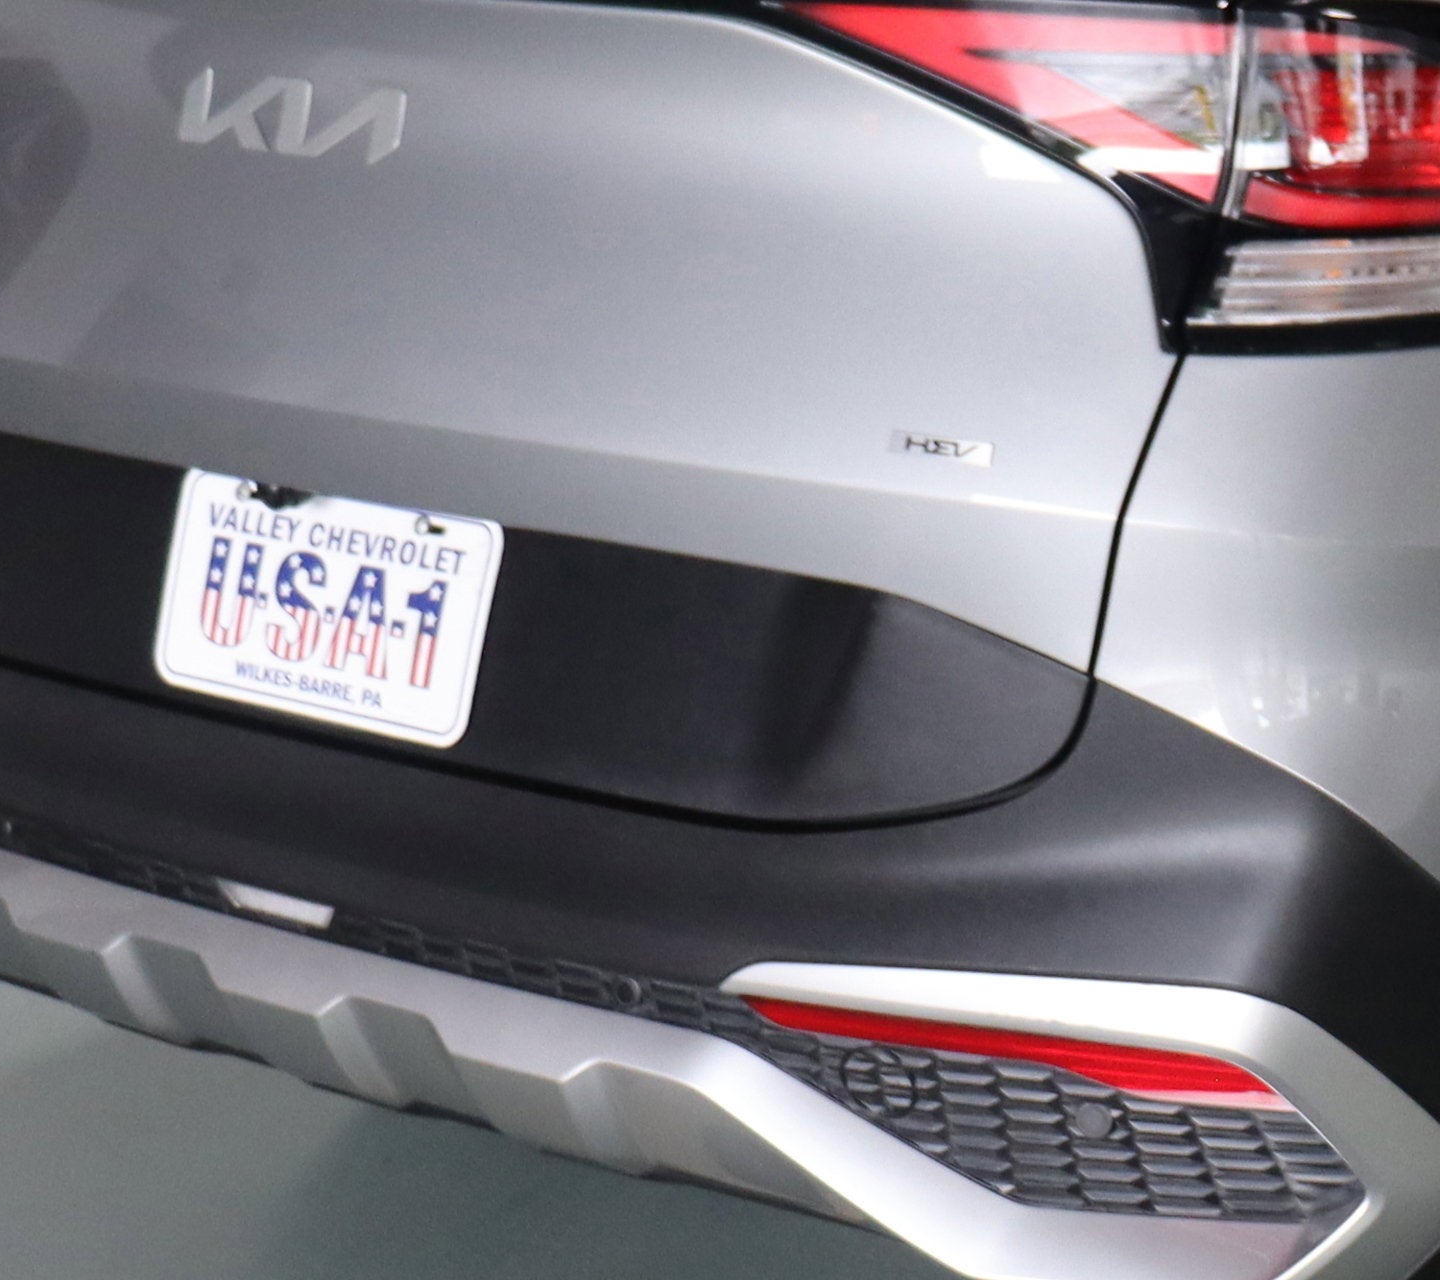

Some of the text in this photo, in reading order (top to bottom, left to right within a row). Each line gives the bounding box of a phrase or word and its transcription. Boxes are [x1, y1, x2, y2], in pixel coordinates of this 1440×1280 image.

[209, 501, 468, 576] VALLEY CHEVROLET
[361, 688, 384, 709] PA
